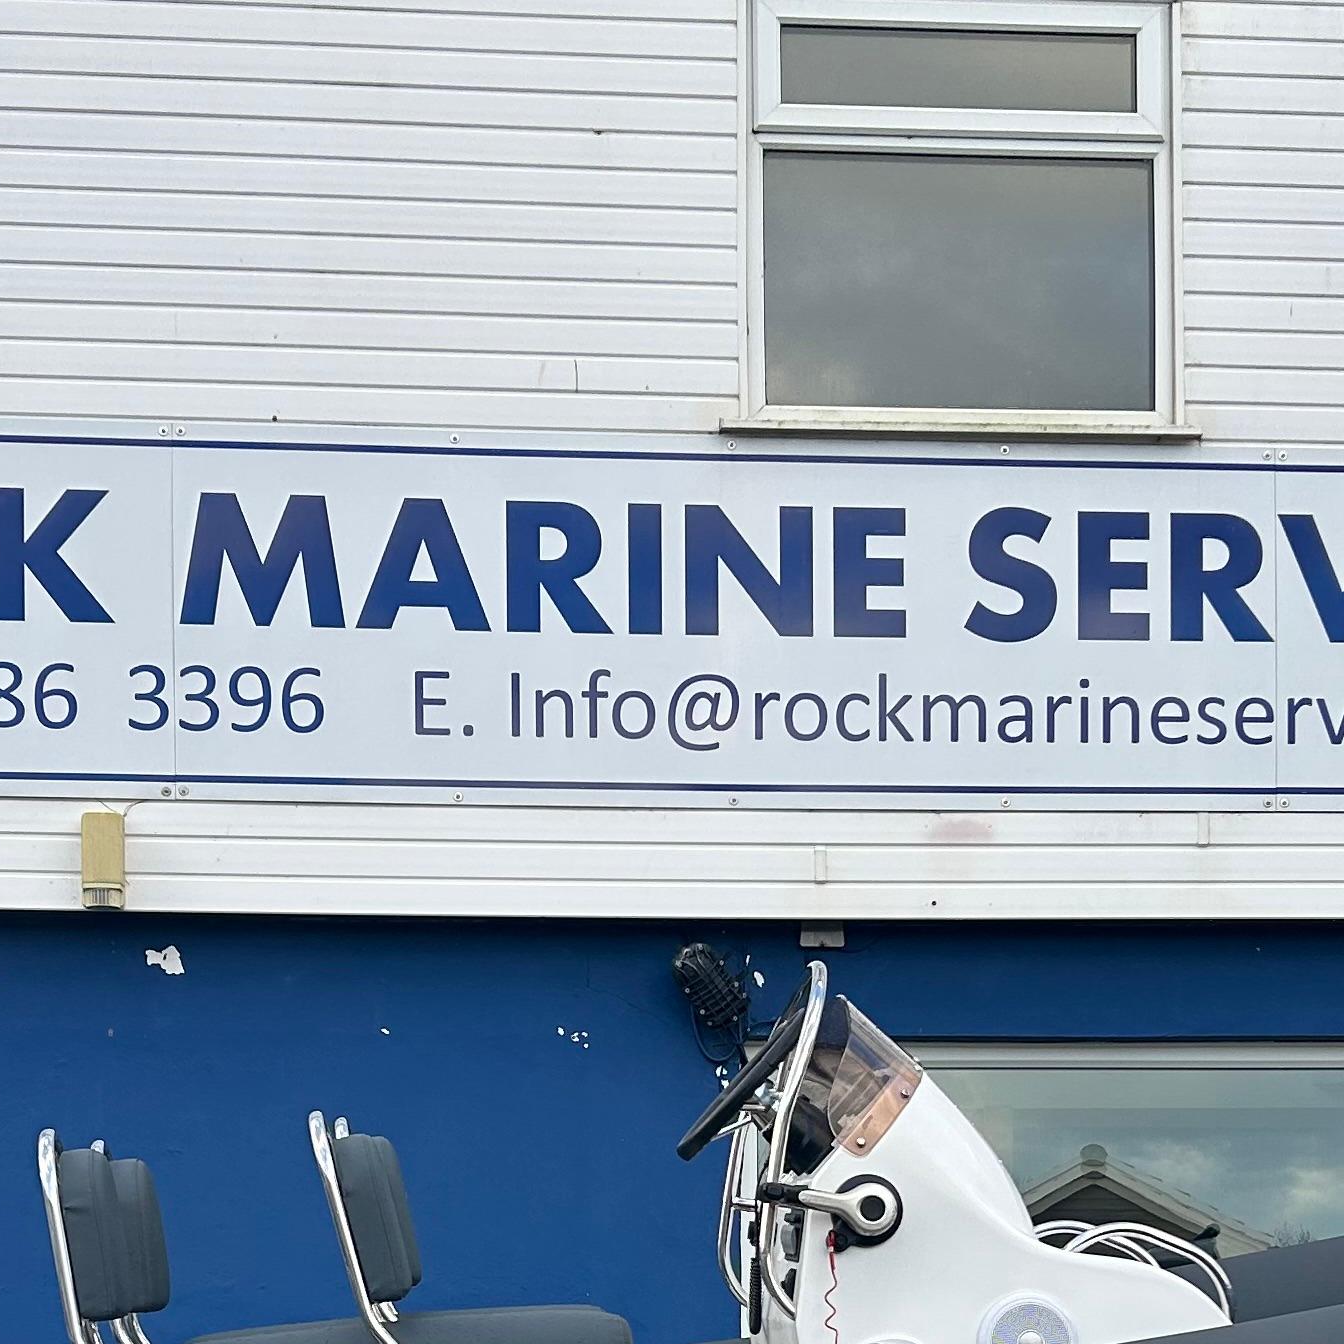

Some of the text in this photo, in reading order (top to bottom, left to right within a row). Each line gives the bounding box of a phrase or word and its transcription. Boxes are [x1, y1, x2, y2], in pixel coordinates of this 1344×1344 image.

[180, 492, 906, 638] MARINE
[129, 665, 324, 733] 3396
[415, 671, 473, 736] E.
